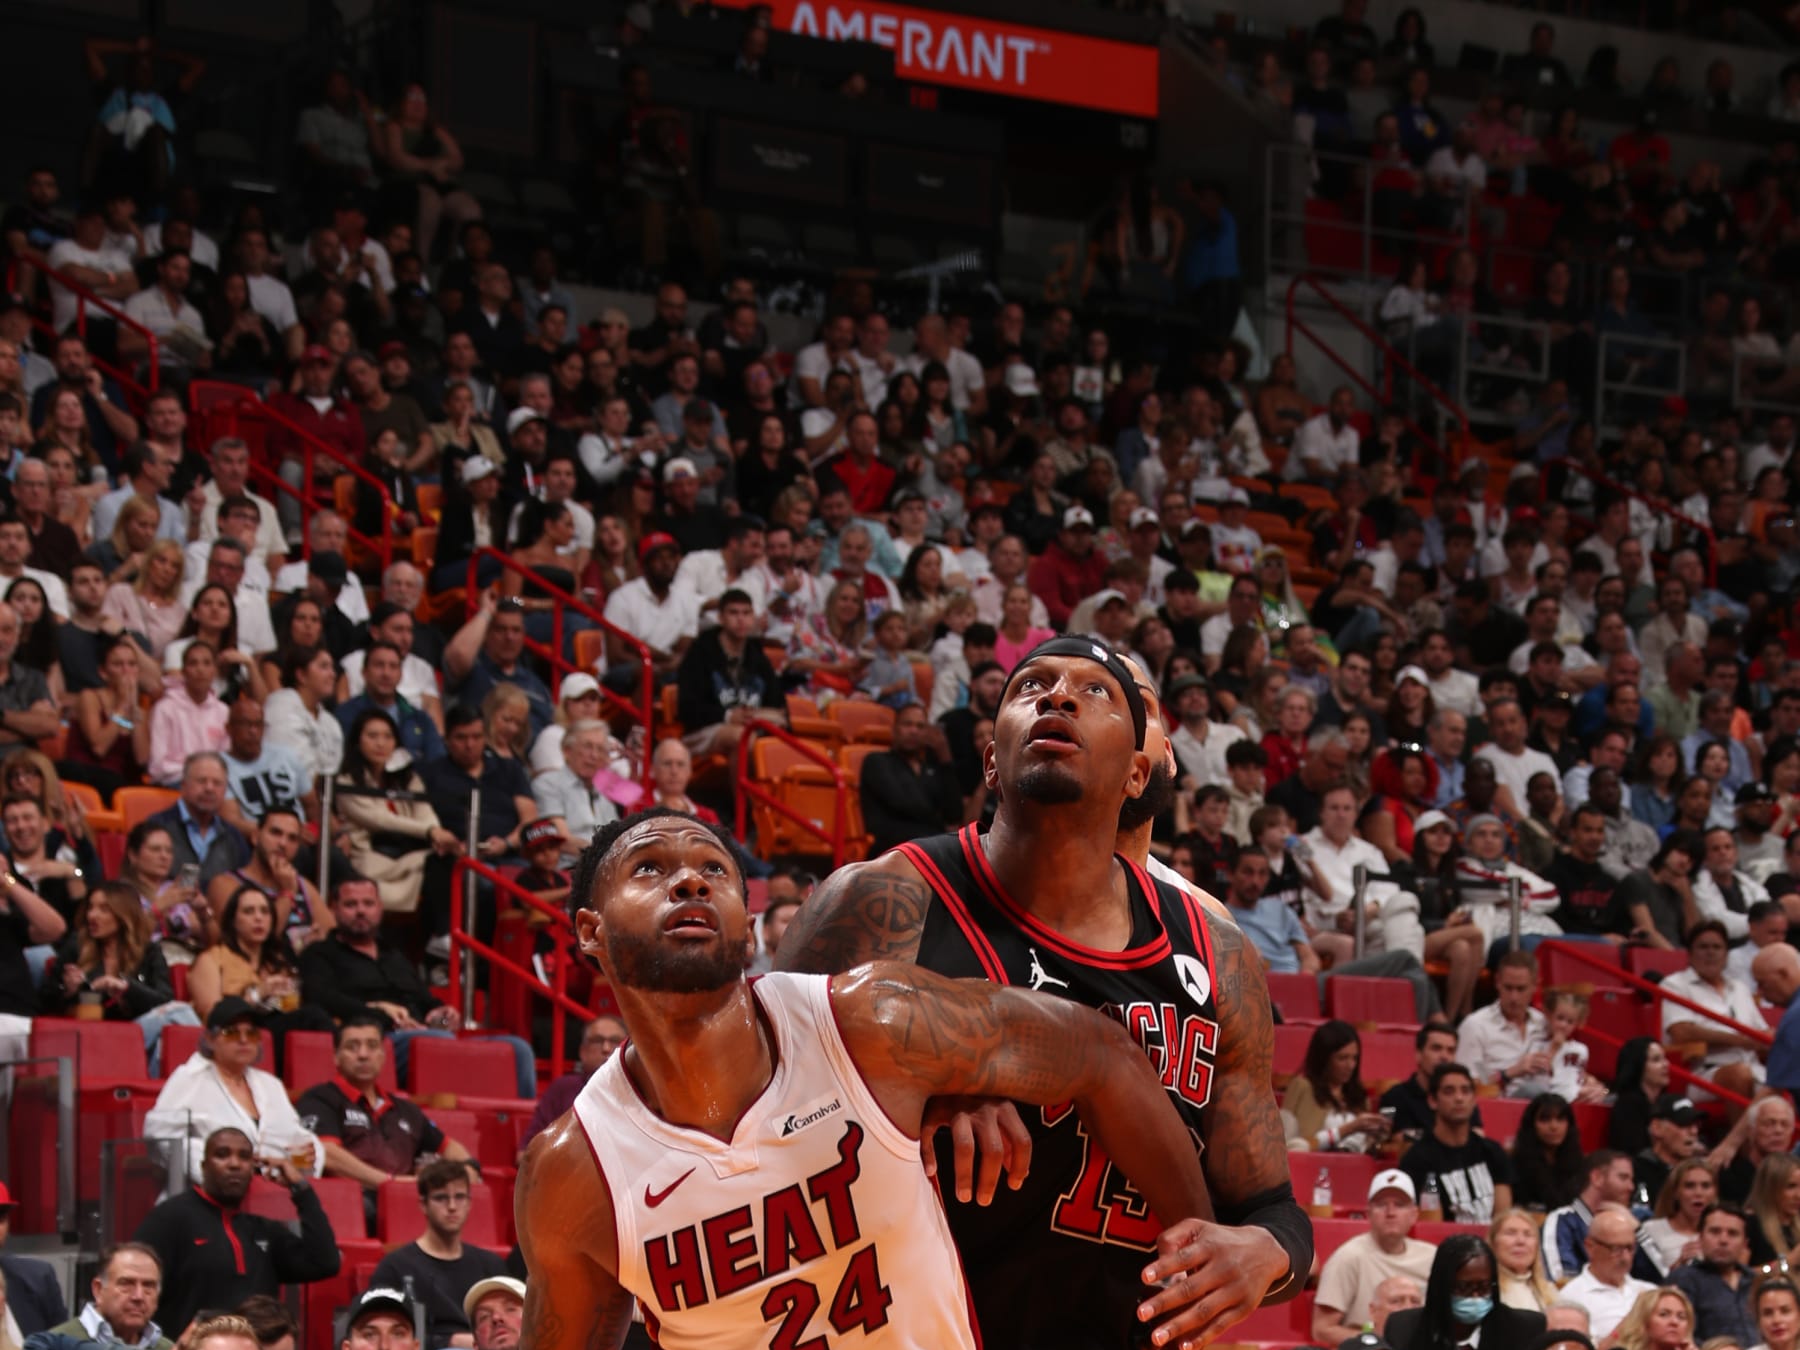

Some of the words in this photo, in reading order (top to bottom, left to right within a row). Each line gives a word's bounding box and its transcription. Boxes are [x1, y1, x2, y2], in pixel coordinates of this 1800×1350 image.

[790, 3, 1036, 85] AMERANT
[793, 1098, 842, 1130] Carnival
[643, 1119, 865, 1312] HEAT
